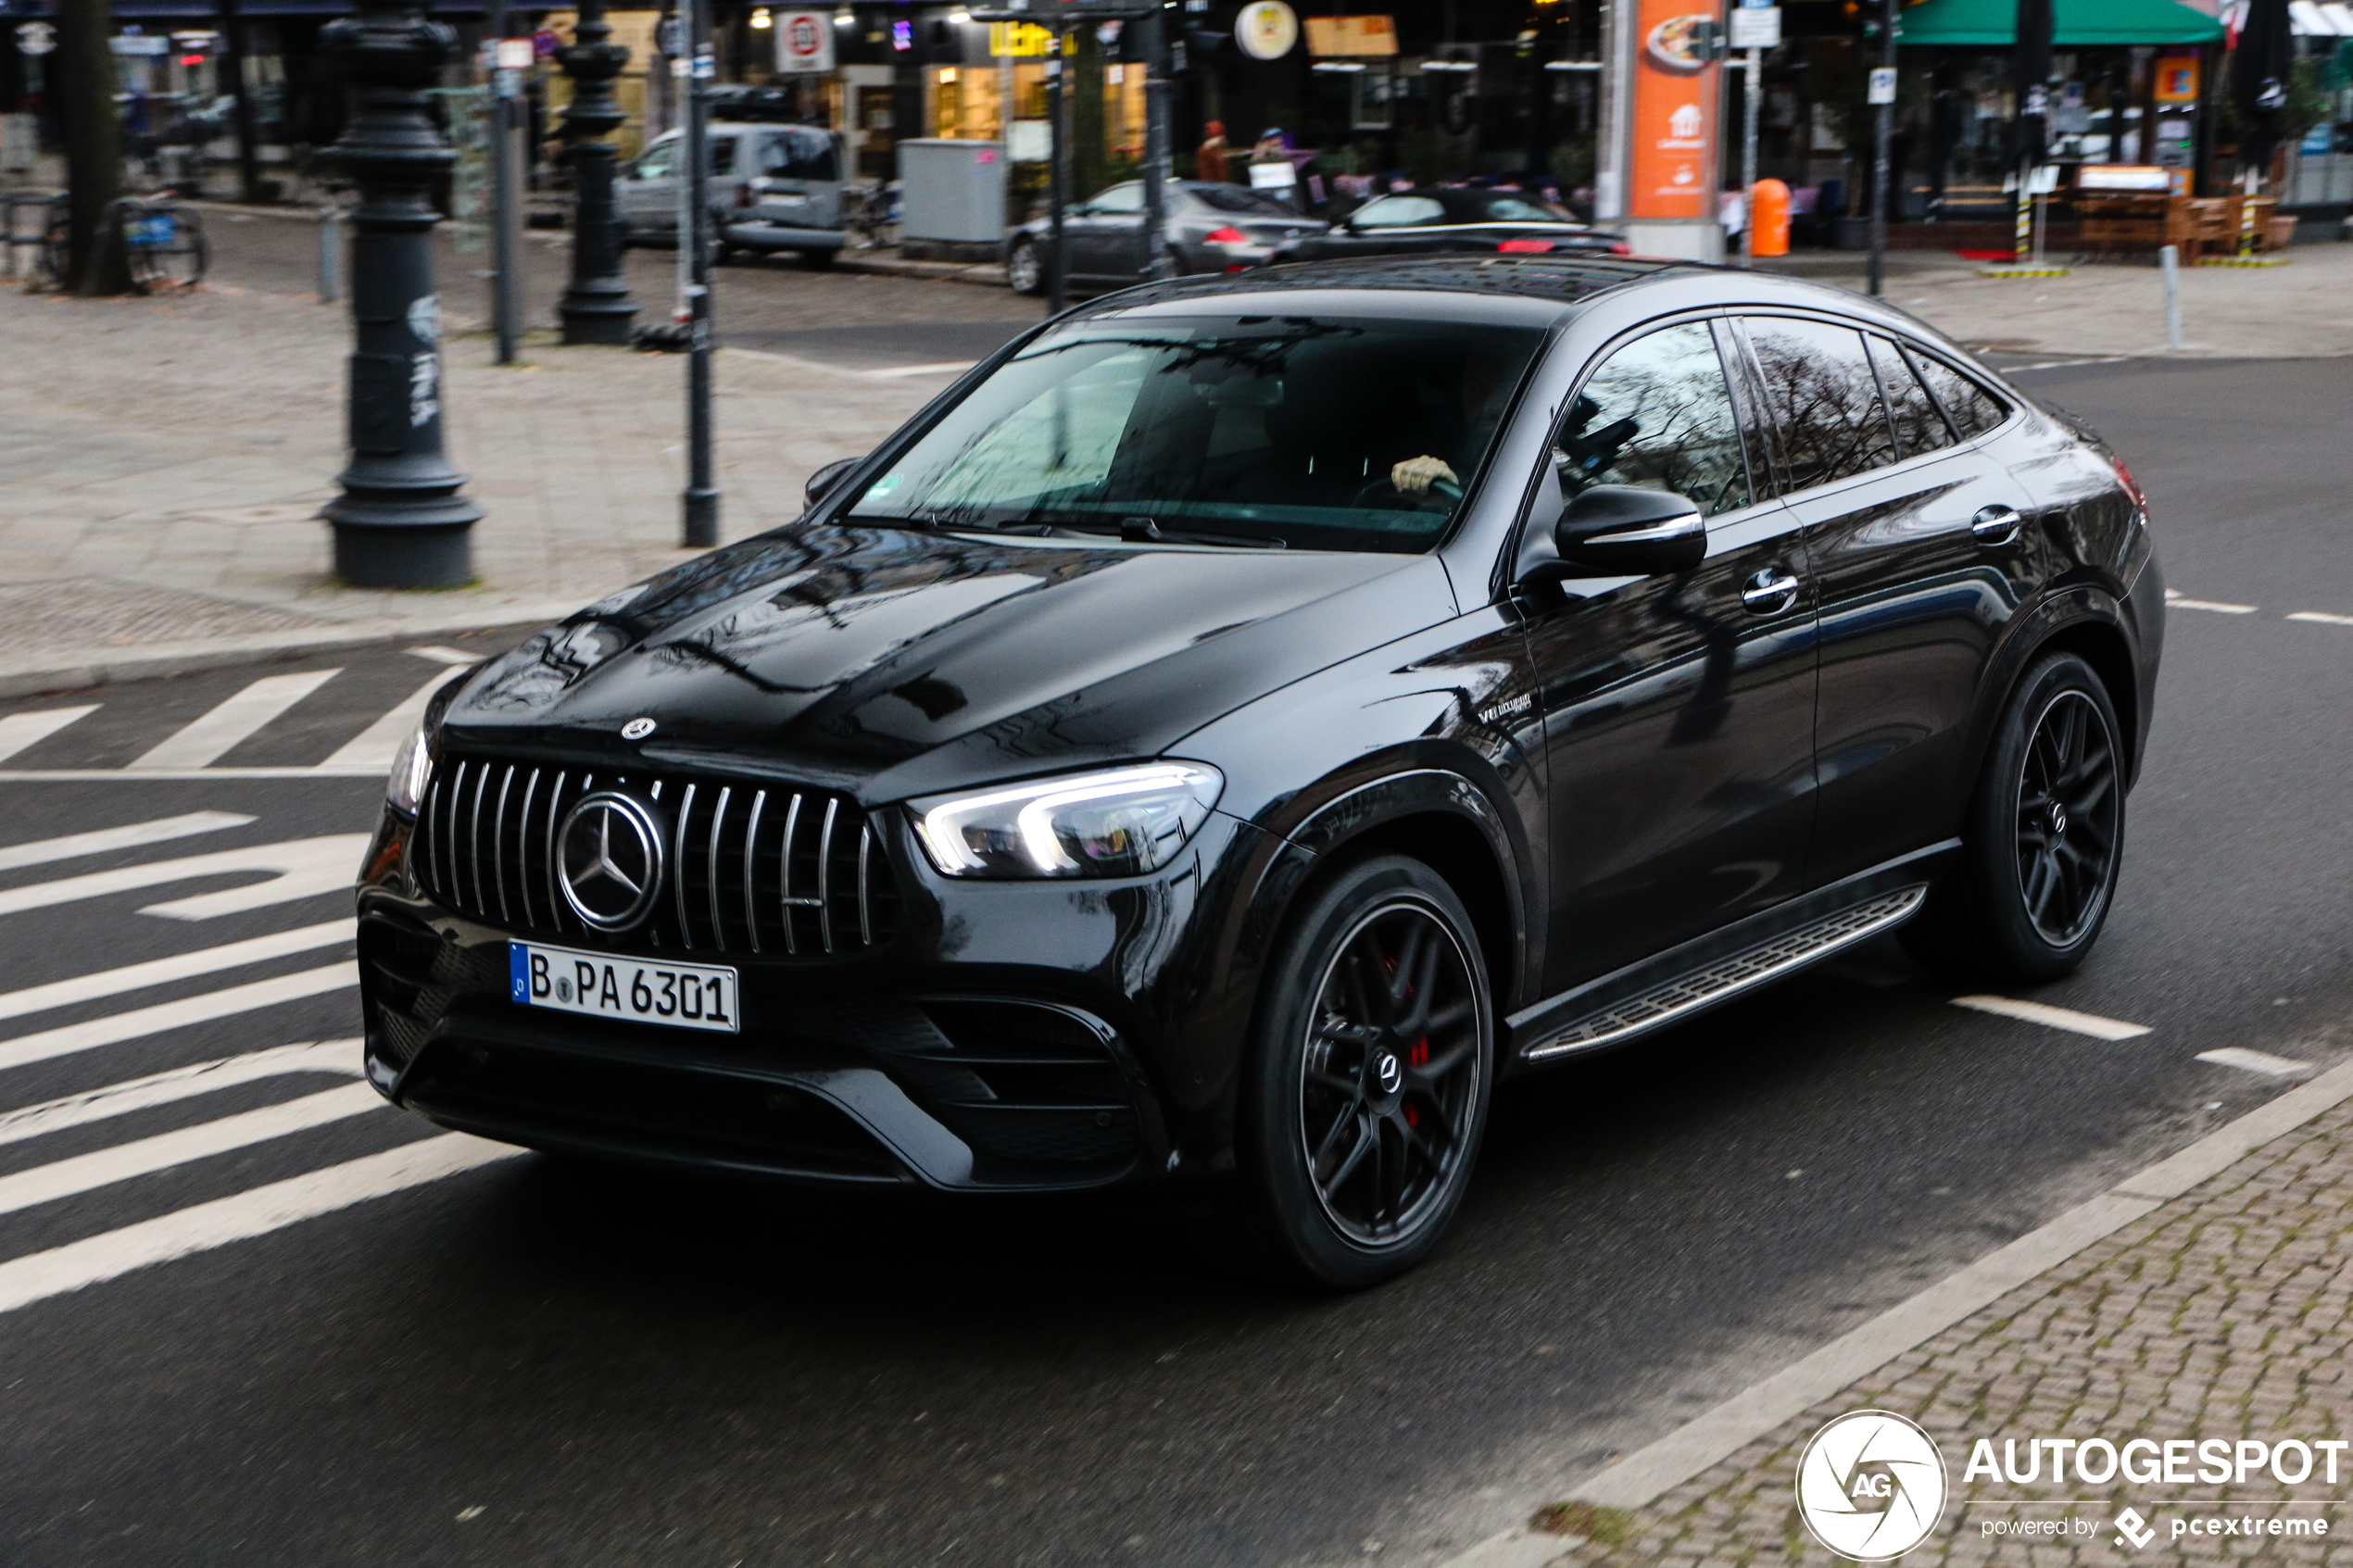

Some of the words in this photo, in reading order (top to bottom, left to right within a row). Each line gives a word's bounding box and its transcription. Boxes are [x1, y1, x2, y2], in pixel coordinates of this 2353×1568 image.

[516, 978, 524, 993] D
[530, 953, 551, 997] B
[574, 960, 621, 1010] PA
[631, 969, 729, 1022] 6301
